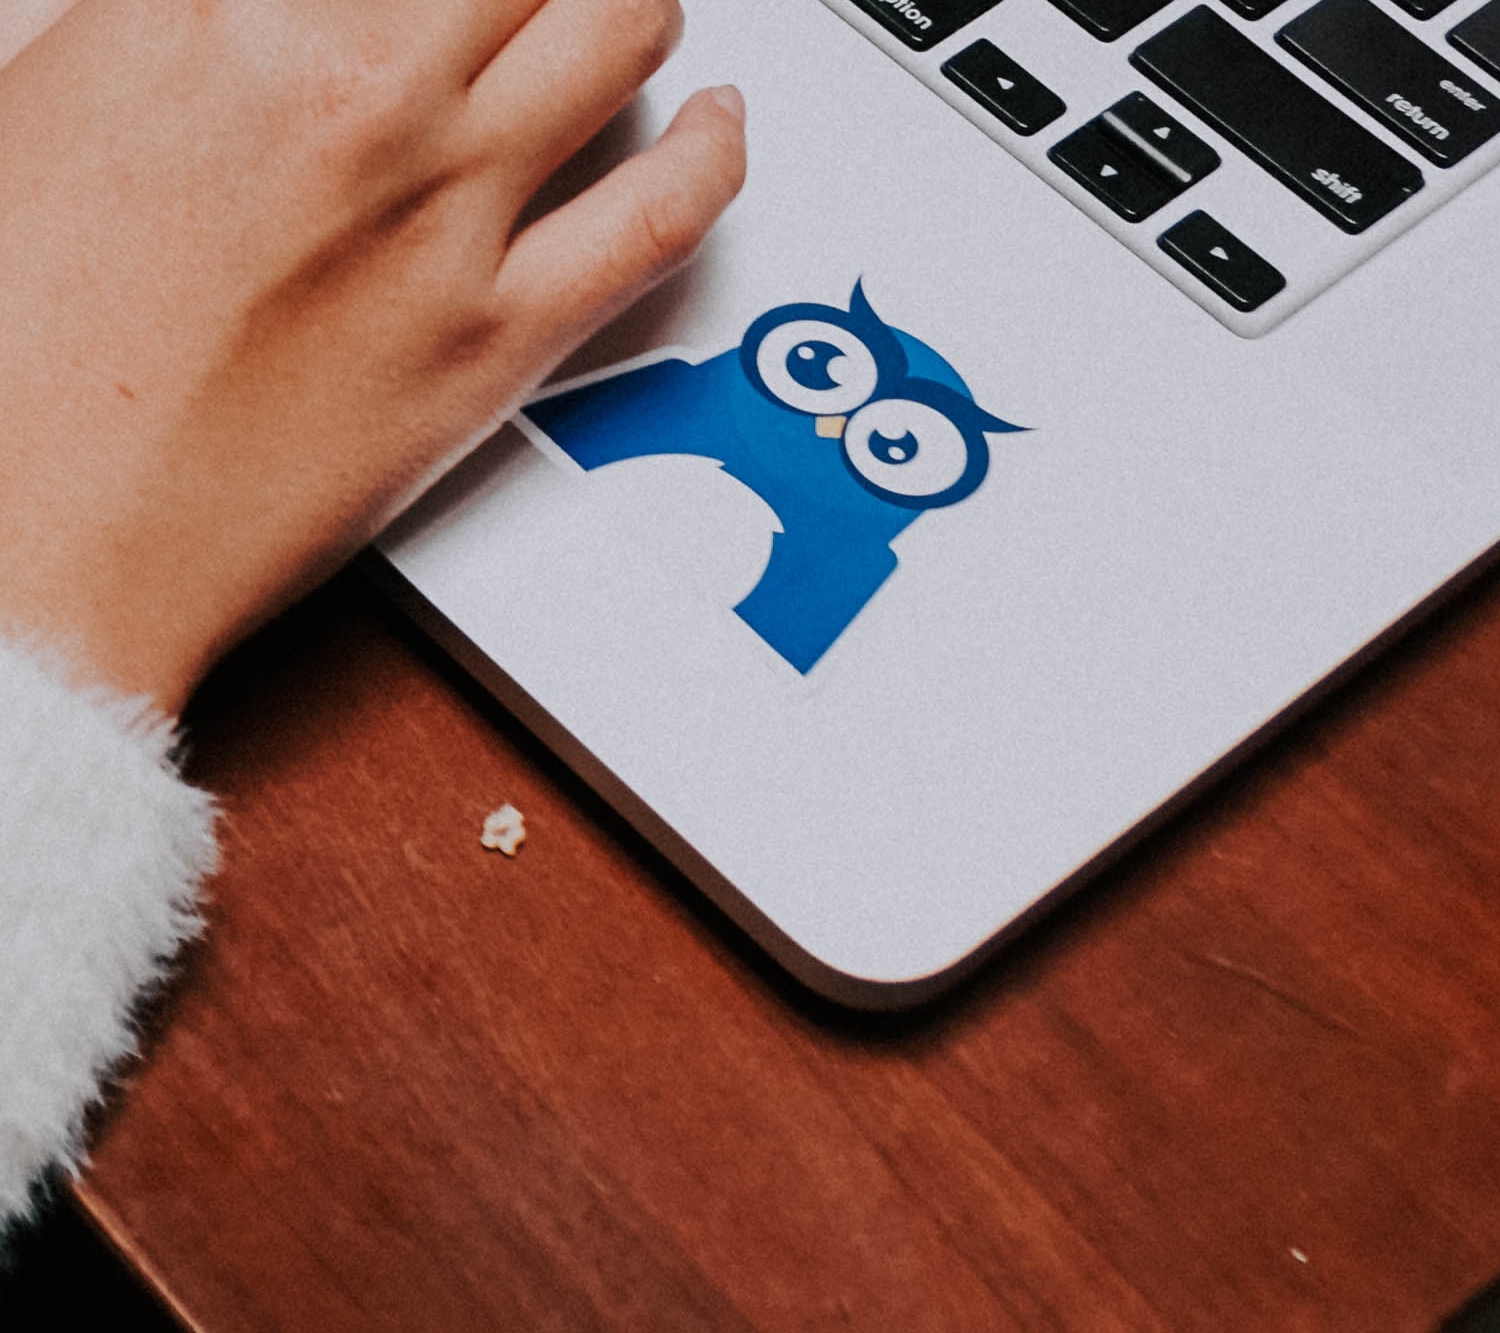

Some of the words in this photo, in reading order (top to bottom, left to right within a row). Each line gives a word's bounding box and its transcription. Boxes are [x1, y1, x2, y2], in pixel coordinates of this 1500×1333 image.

[1438, 75, 1489, 113] enter
[1384, 91, 1451, 142] return
[1309, 164, 1364, 205] shift
